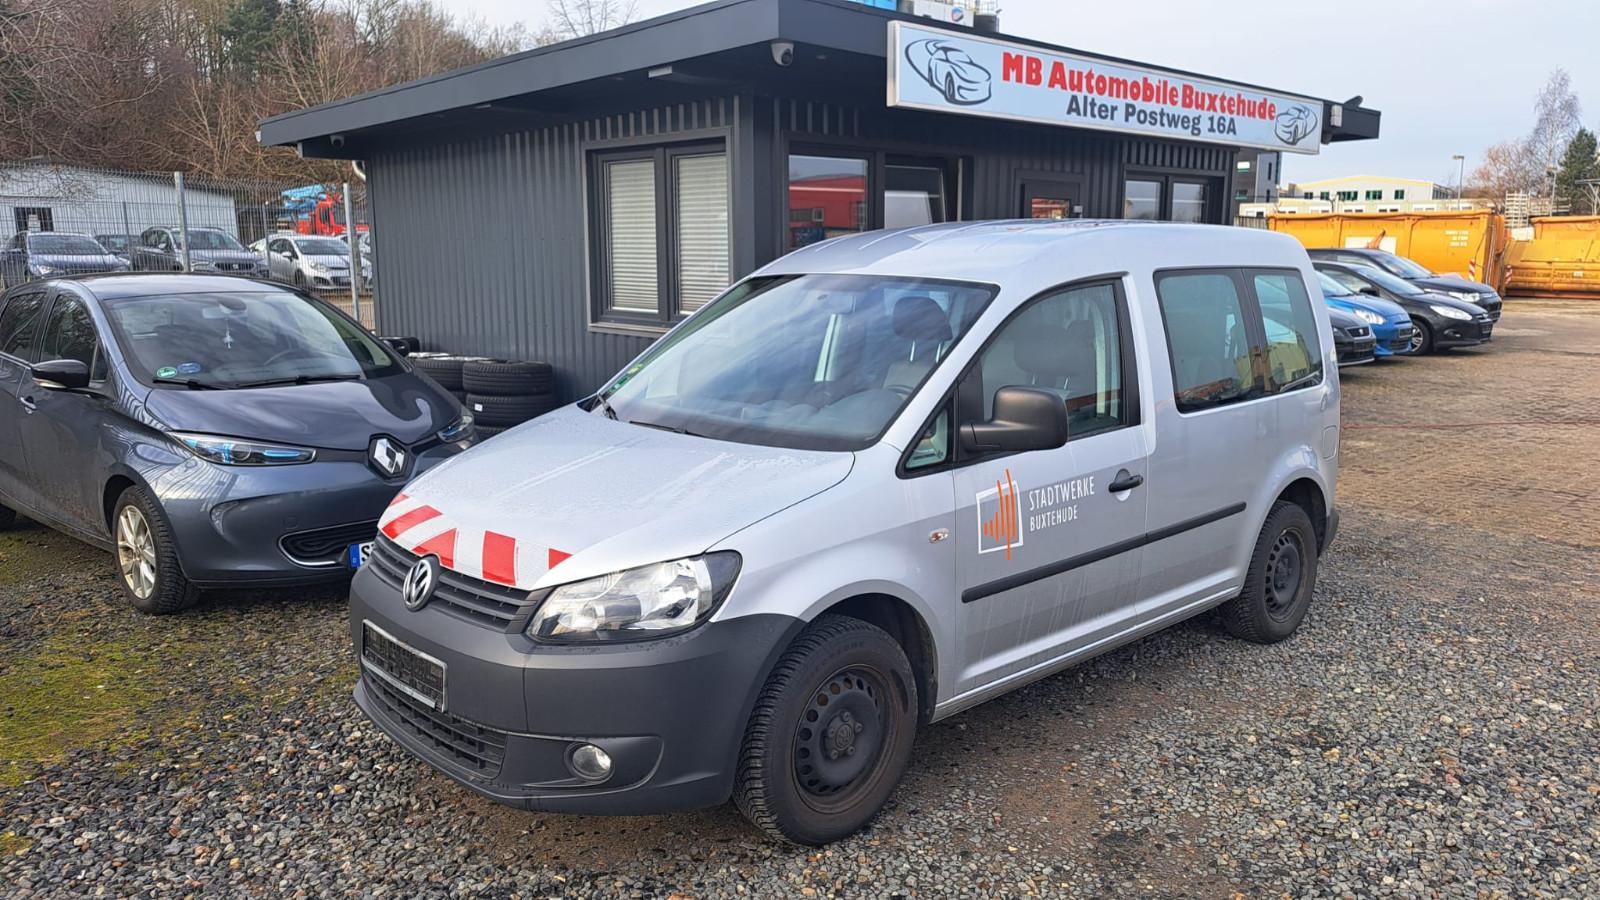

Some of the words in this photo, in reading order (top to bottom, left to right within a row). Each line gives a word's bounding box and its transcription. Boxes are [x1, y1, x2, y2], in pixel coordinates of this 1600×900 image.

[1002, 51, 1042, 86] MB
[1047, 60, 1179, 106] Automobile
[1181, 82, 1277, 121] Buxtehude
[1066, 94, 1118, 121] Alter
[1123, 101, 1202, 136] Postweg
[1207, 115, 1238, 136] 16A
[1028, 475, 1096, 512] STADTWERKE
[1029, 504, 1079, 533] BUXTEHUDE
